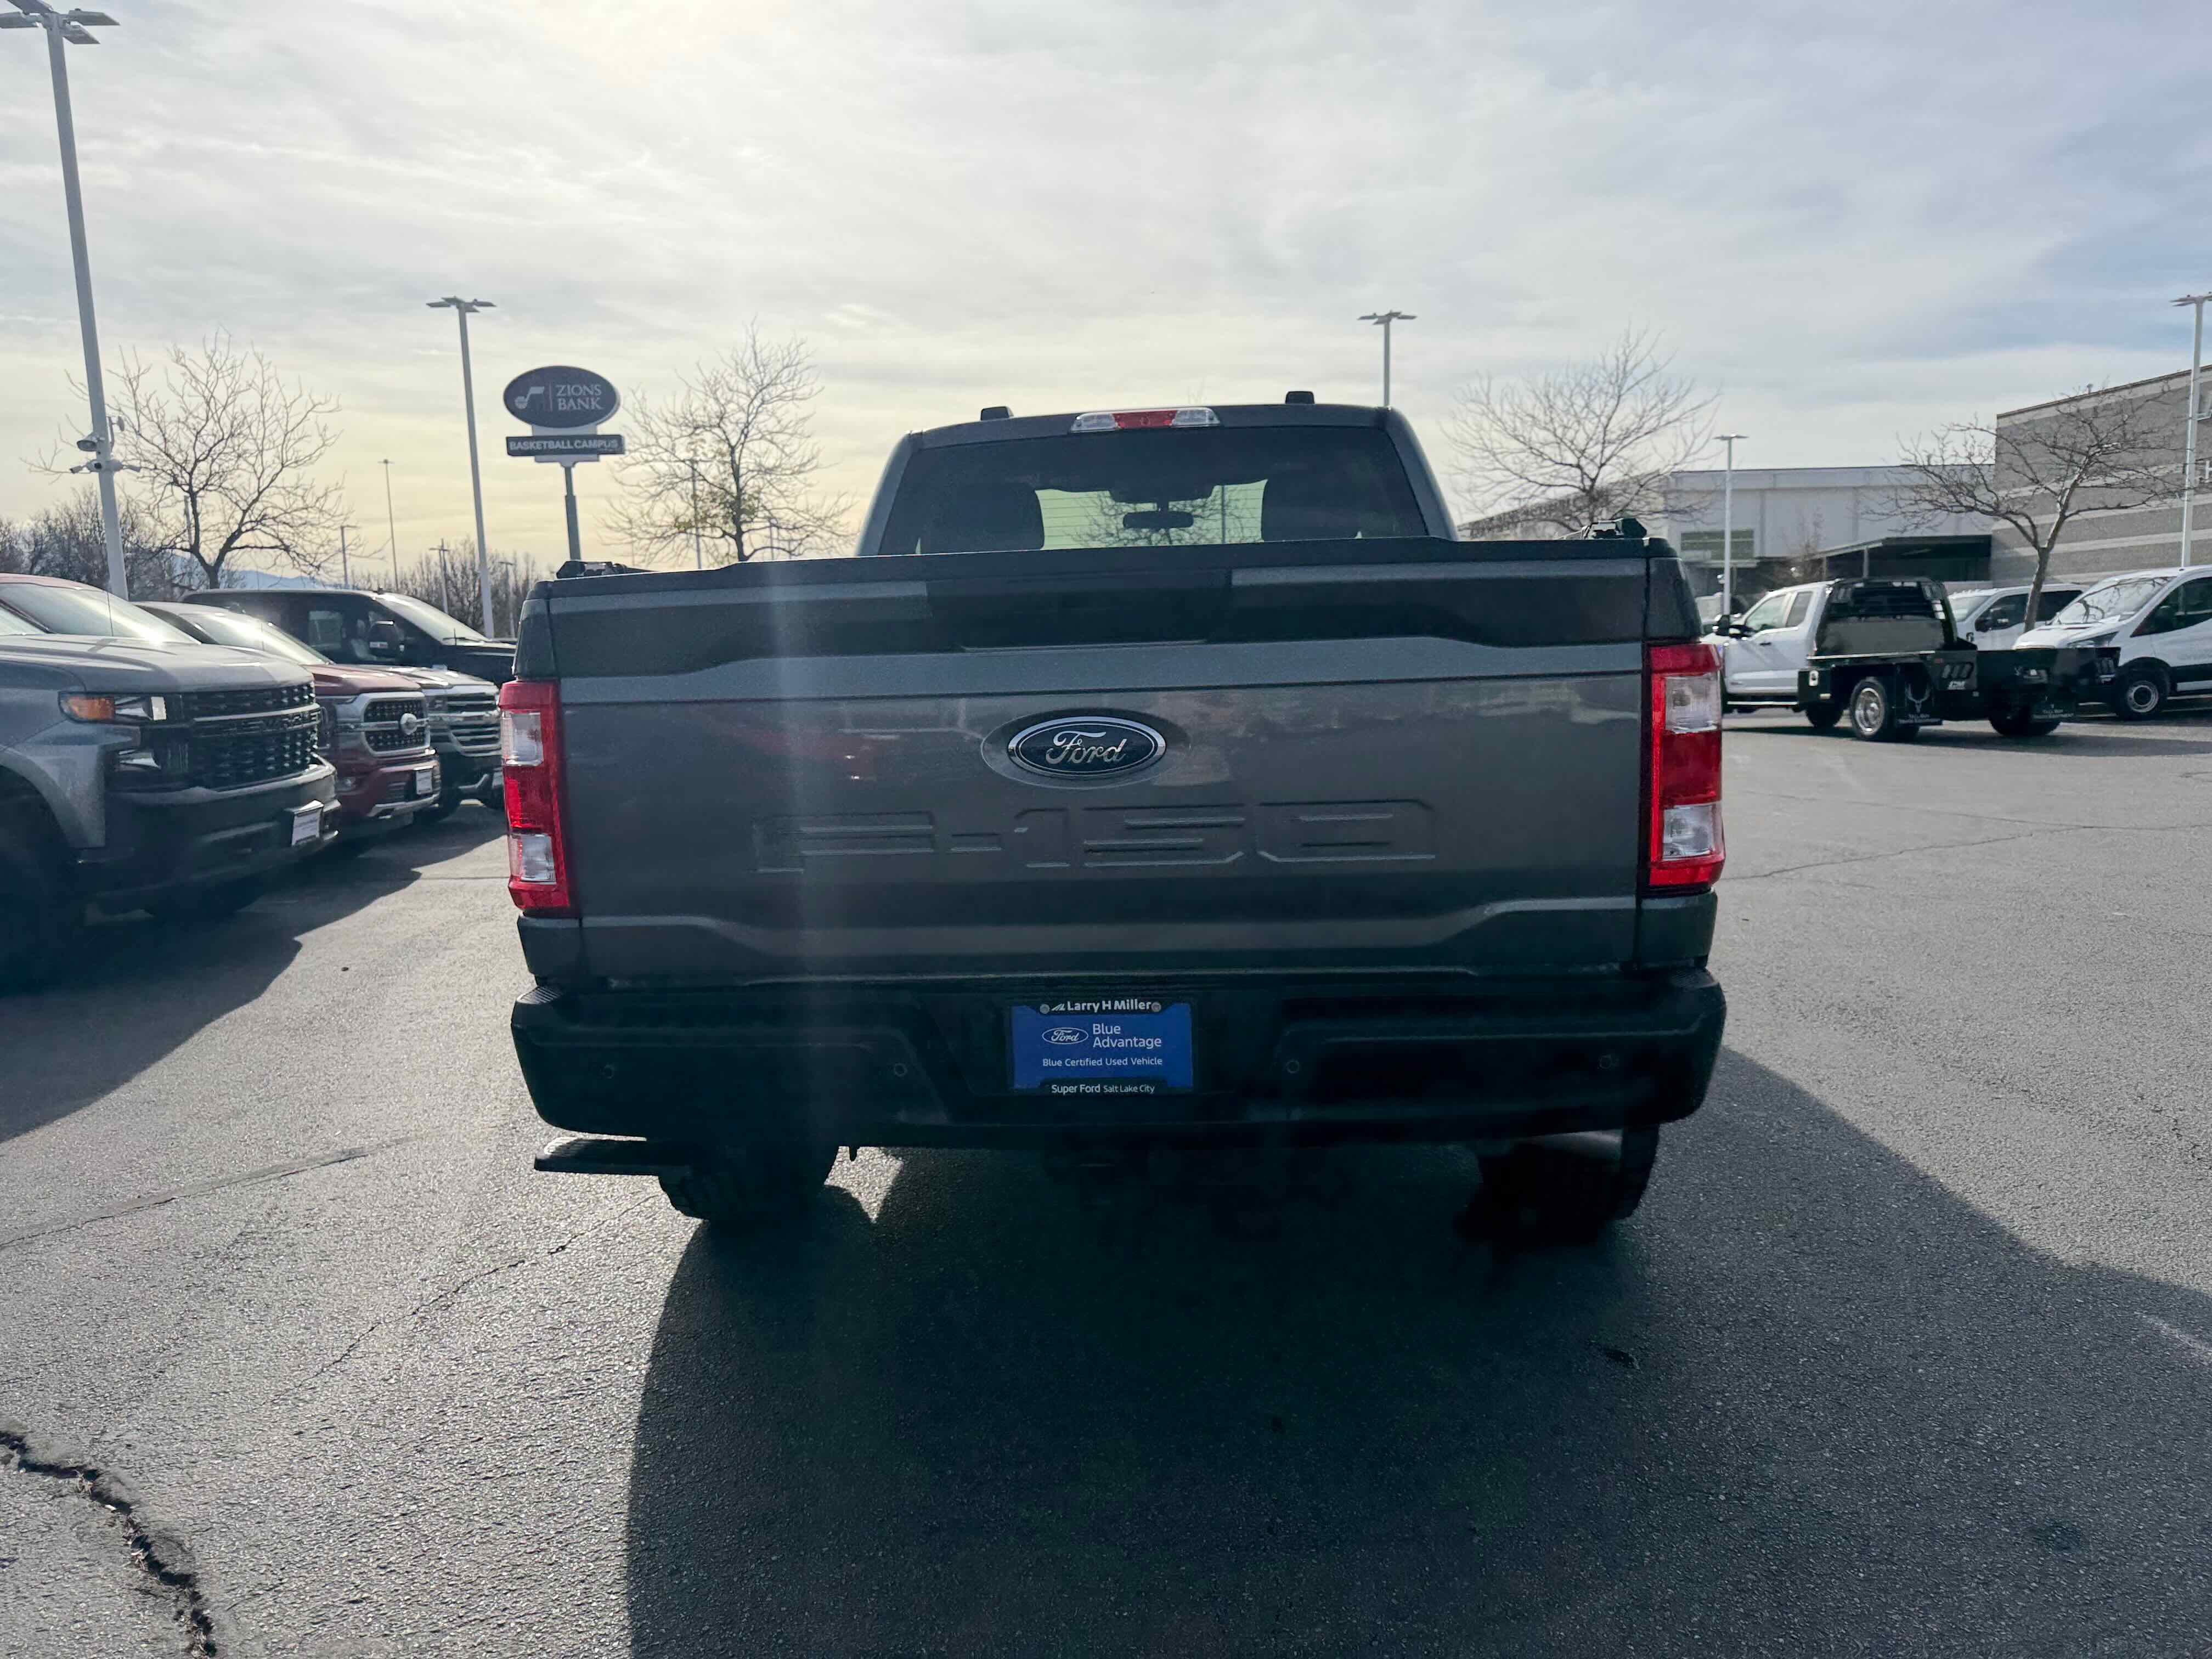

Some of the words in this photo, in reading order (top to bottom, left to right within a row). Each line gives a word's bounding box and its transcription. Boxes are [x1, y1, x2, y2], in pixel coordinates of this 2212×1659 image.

[555, 384, 602, 397] ZIONS
[557, 397, 603, 410] BANK
[509, 441, 574, 450] BASKETBALL
[574, 439, 618, 449] CAMPUS
[1045, 730, 1127, 764] Ford
[1067, 1001, 1098, 1012] Larry
[1102, 1000, 1111, 1010] H
[1114, 999, 1152, 1010] Miller
[1051, 1029, 1079, 1042] Ford
[1093, 1024, 1121, 1035] Blue
[1093, 1036, 1162, 1049] Advantage
[1042, 1058, 1063, 1066] Blue
[1065, 1058, 1102, 1066] Certified
[1130, 1057, 1163, 1065] Vehicle
[1052, 1085, 1077, 1095] Super
[1080, 1084, 1101, 1093] Ford
[1103, 1085, 1118, 1093] Salt
[1139, 1084, 1155, 1093] City
